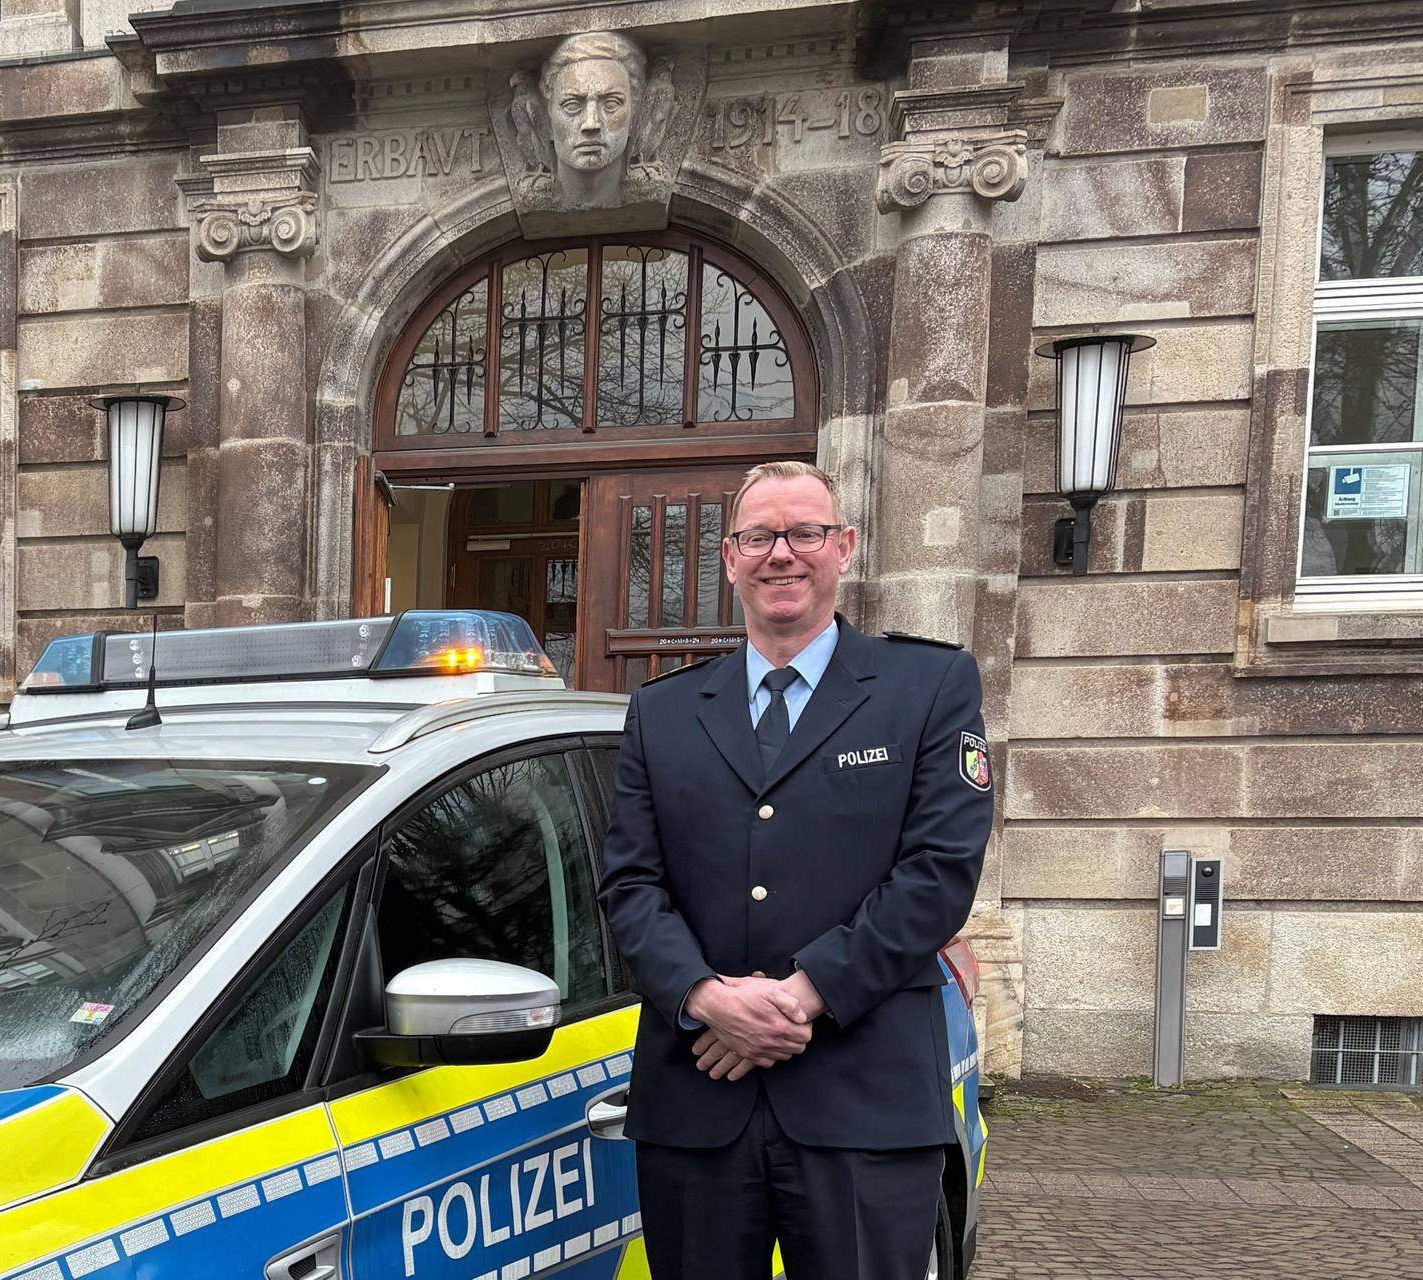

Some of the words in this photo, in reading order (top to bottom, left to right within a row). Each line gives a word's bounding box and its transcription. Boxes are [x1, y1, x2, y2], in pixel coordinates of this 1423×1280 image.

[708, 88, 882, 149] 1914-18
[837, 746, 889, 768] POLIZEI
[963, 735, 987, 753] POLIZE
[402, 1137, 595, 1277] POLIZEI
